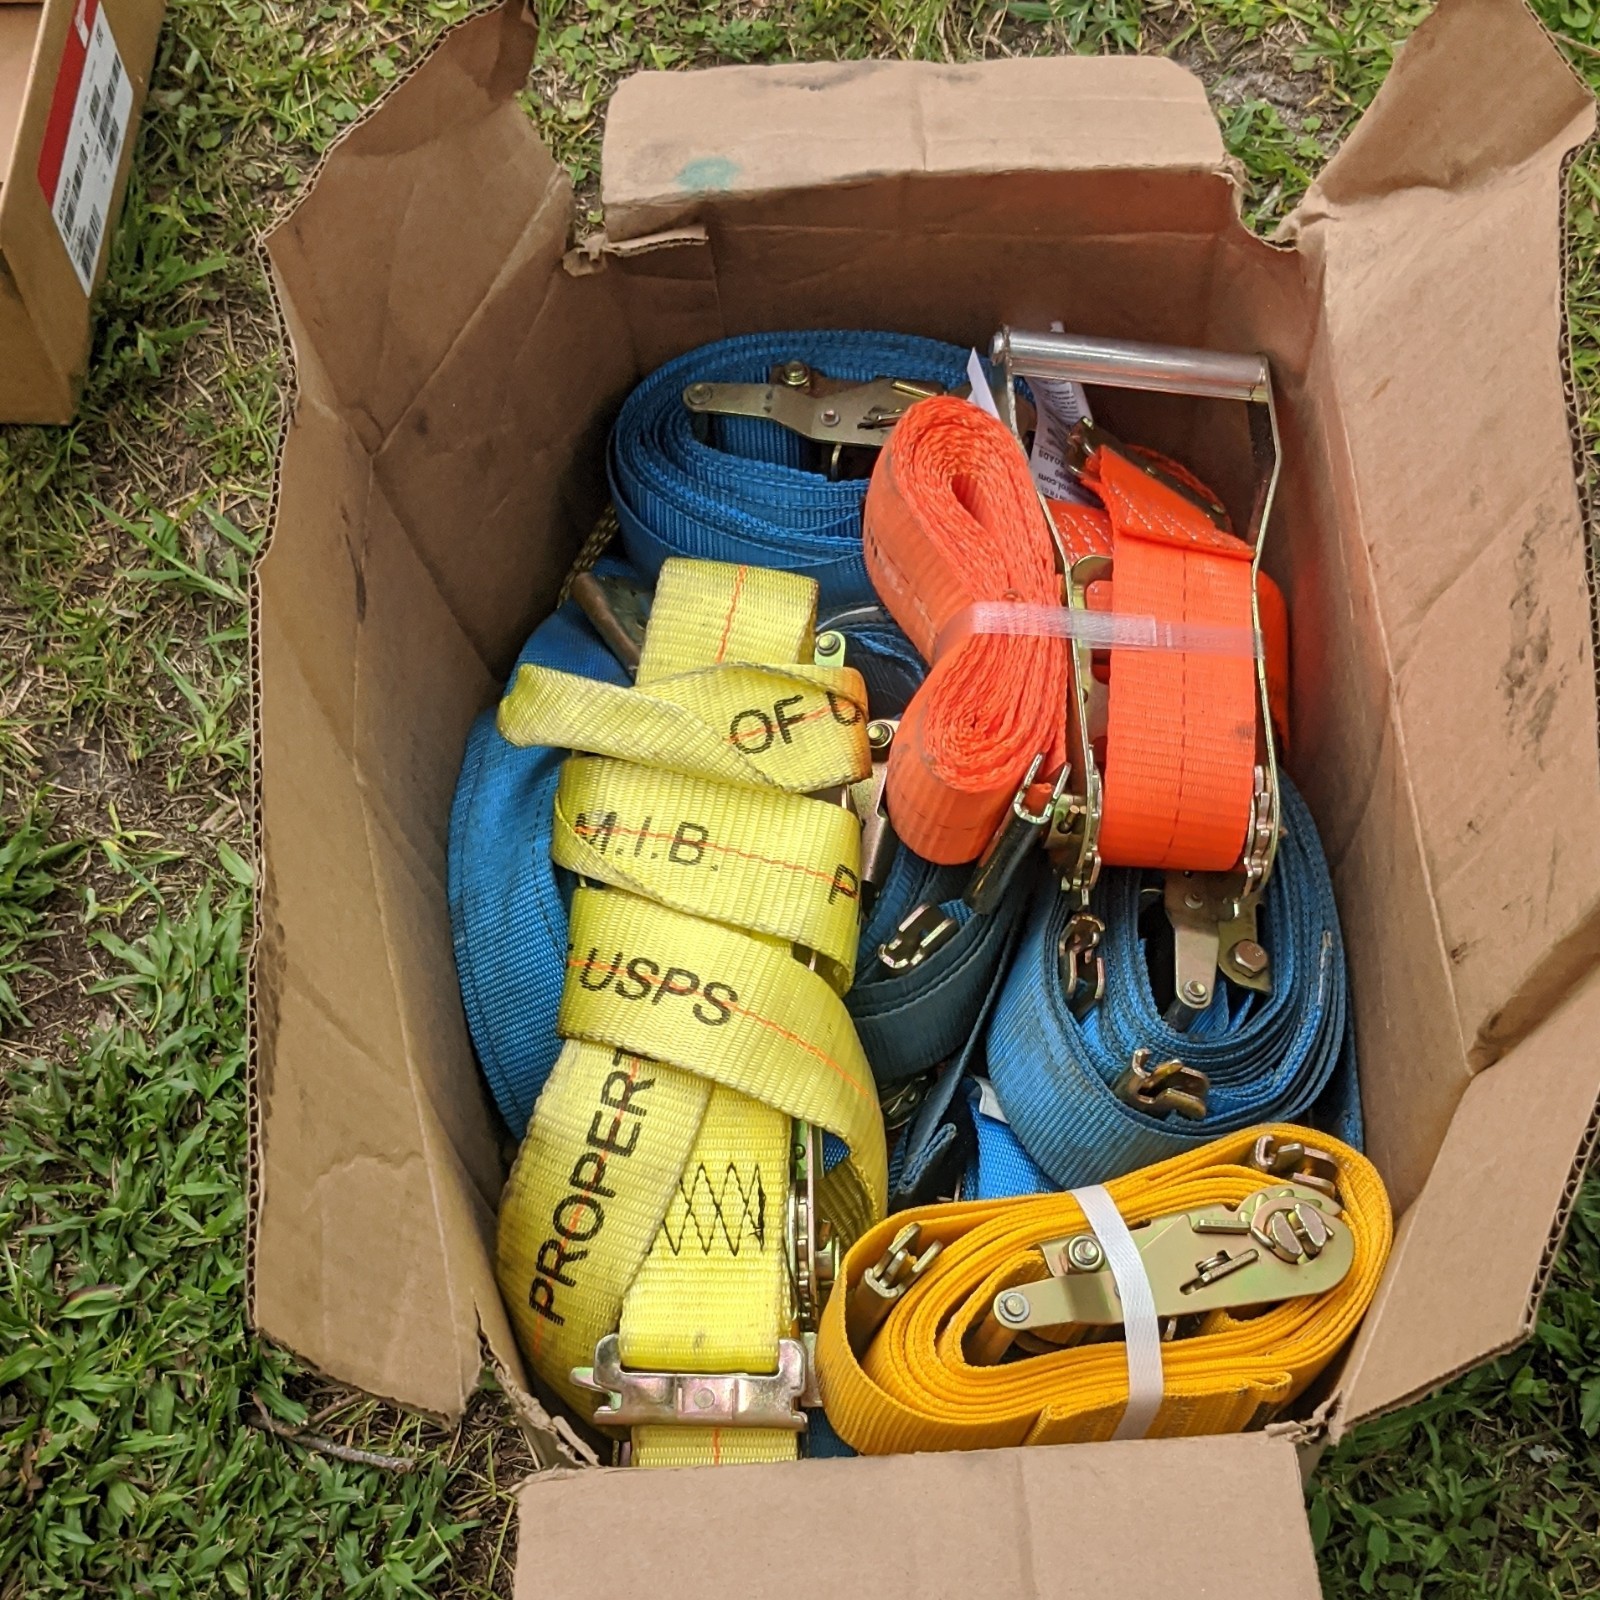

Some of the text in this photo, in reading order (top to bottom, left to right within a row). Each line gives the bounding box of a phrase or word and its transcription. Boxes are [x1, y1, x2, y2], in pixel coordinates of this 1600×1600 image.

[730, 694, 804, 754] OF
[575, 811, 718, 872] M.I.B.
[580, 947, 738, 1025] USPS
